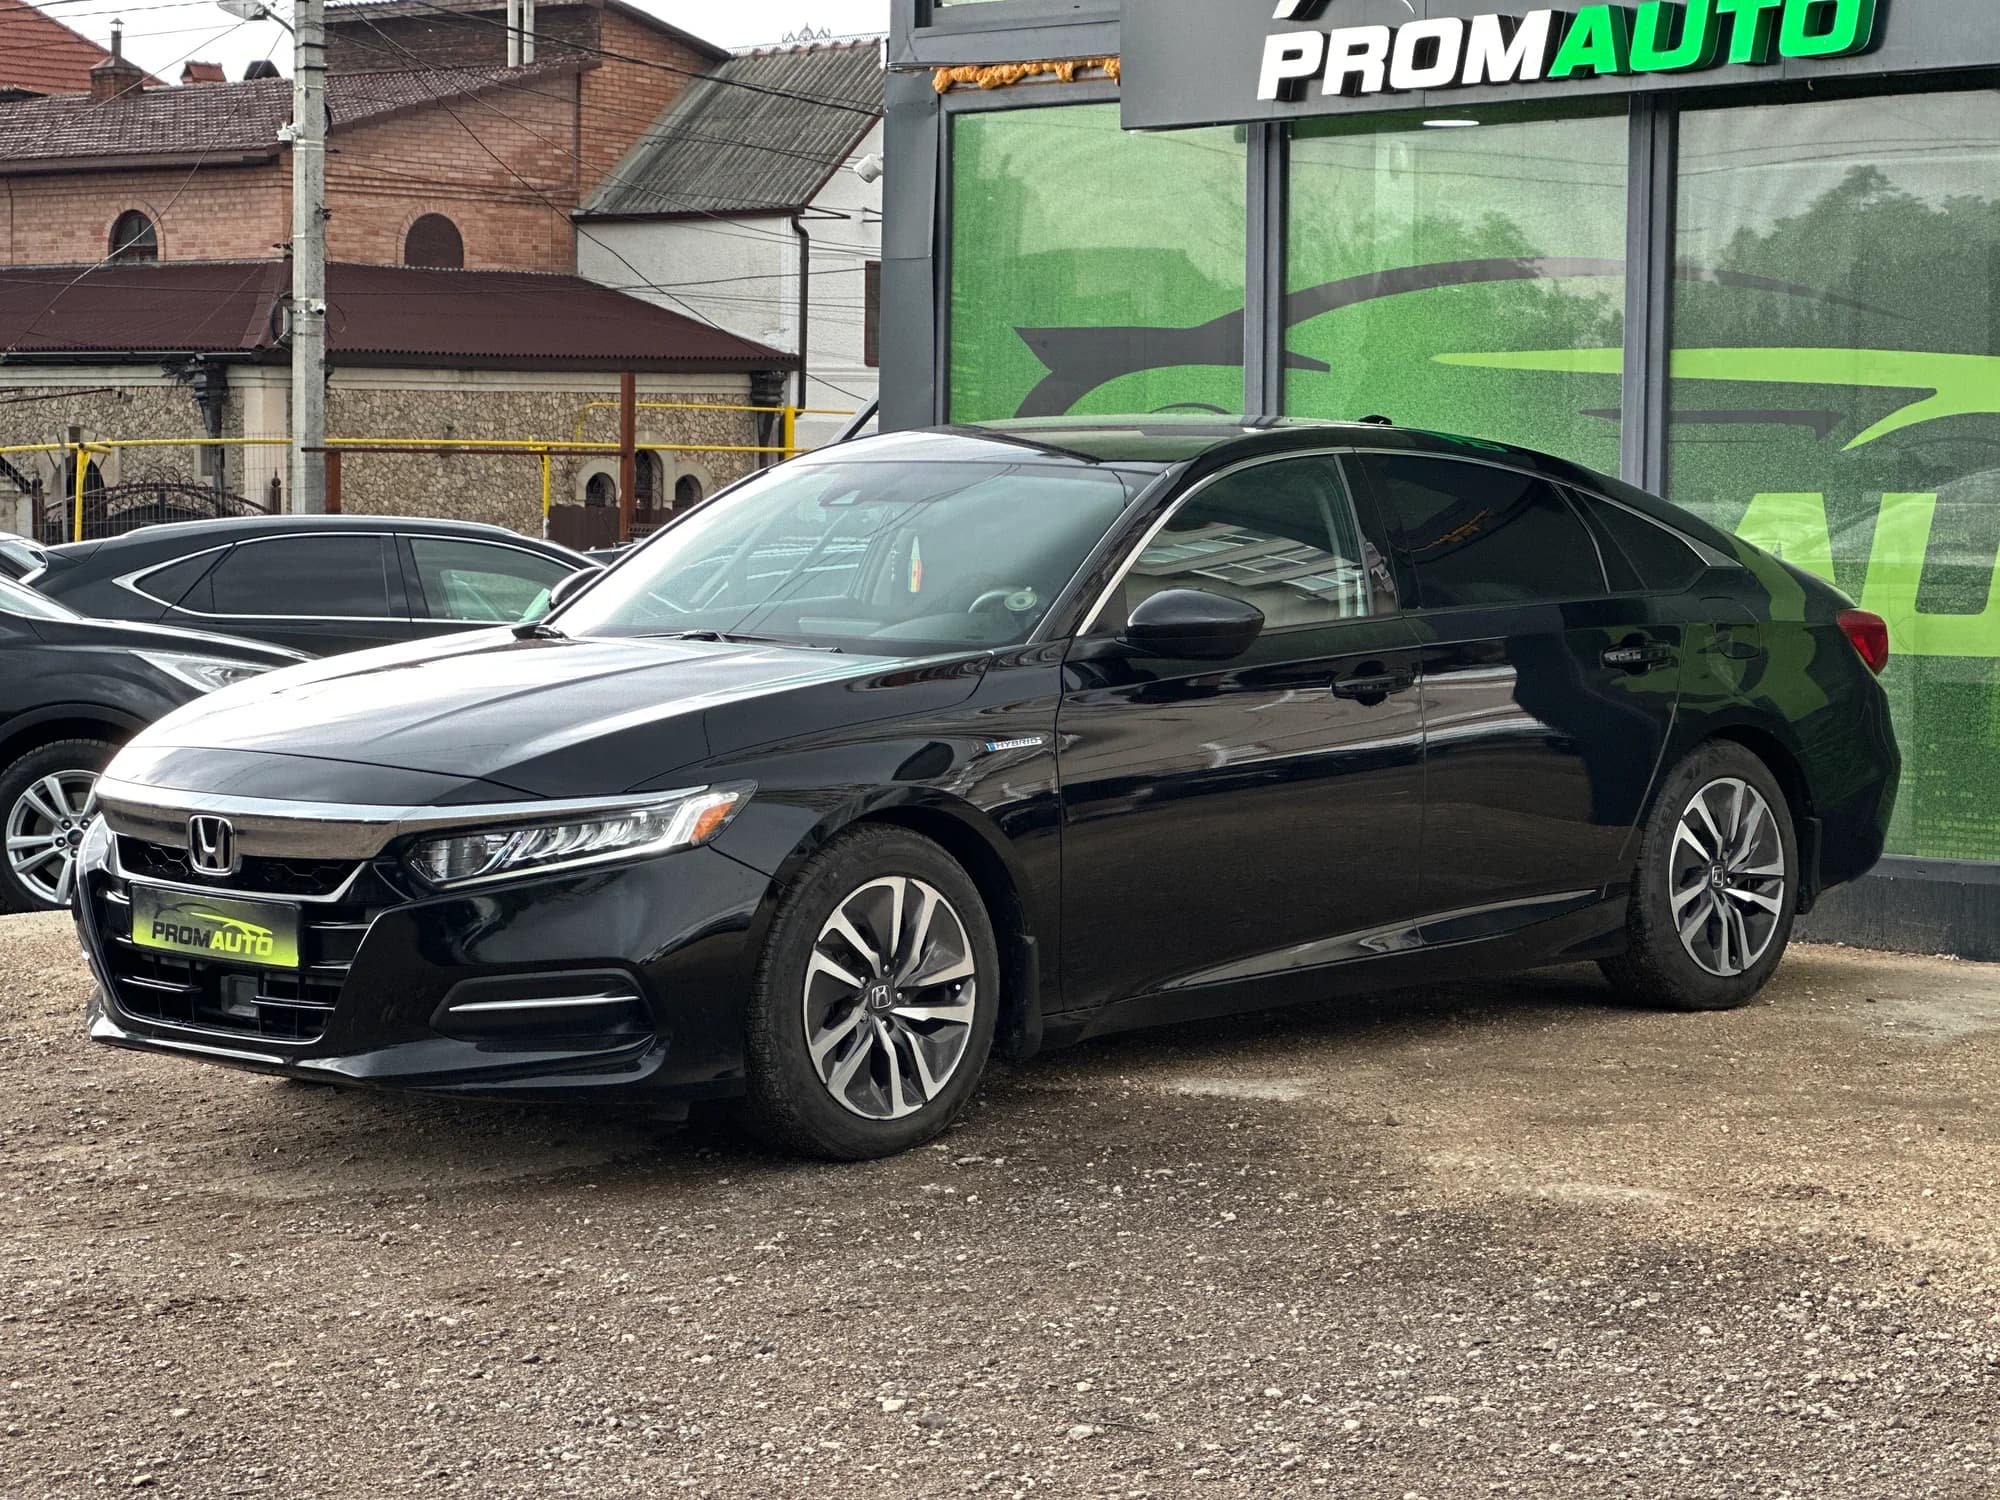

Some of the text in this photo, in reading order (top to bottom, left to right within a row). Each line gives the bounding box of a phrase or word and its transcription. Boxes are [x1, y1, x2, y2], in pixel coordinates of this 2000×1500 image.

[1257, 0, 1866, 101] PROMAUTO
[996, 737, 1039, 749] HYBRID
[151, 920, 274, 957] PROMAUTO
